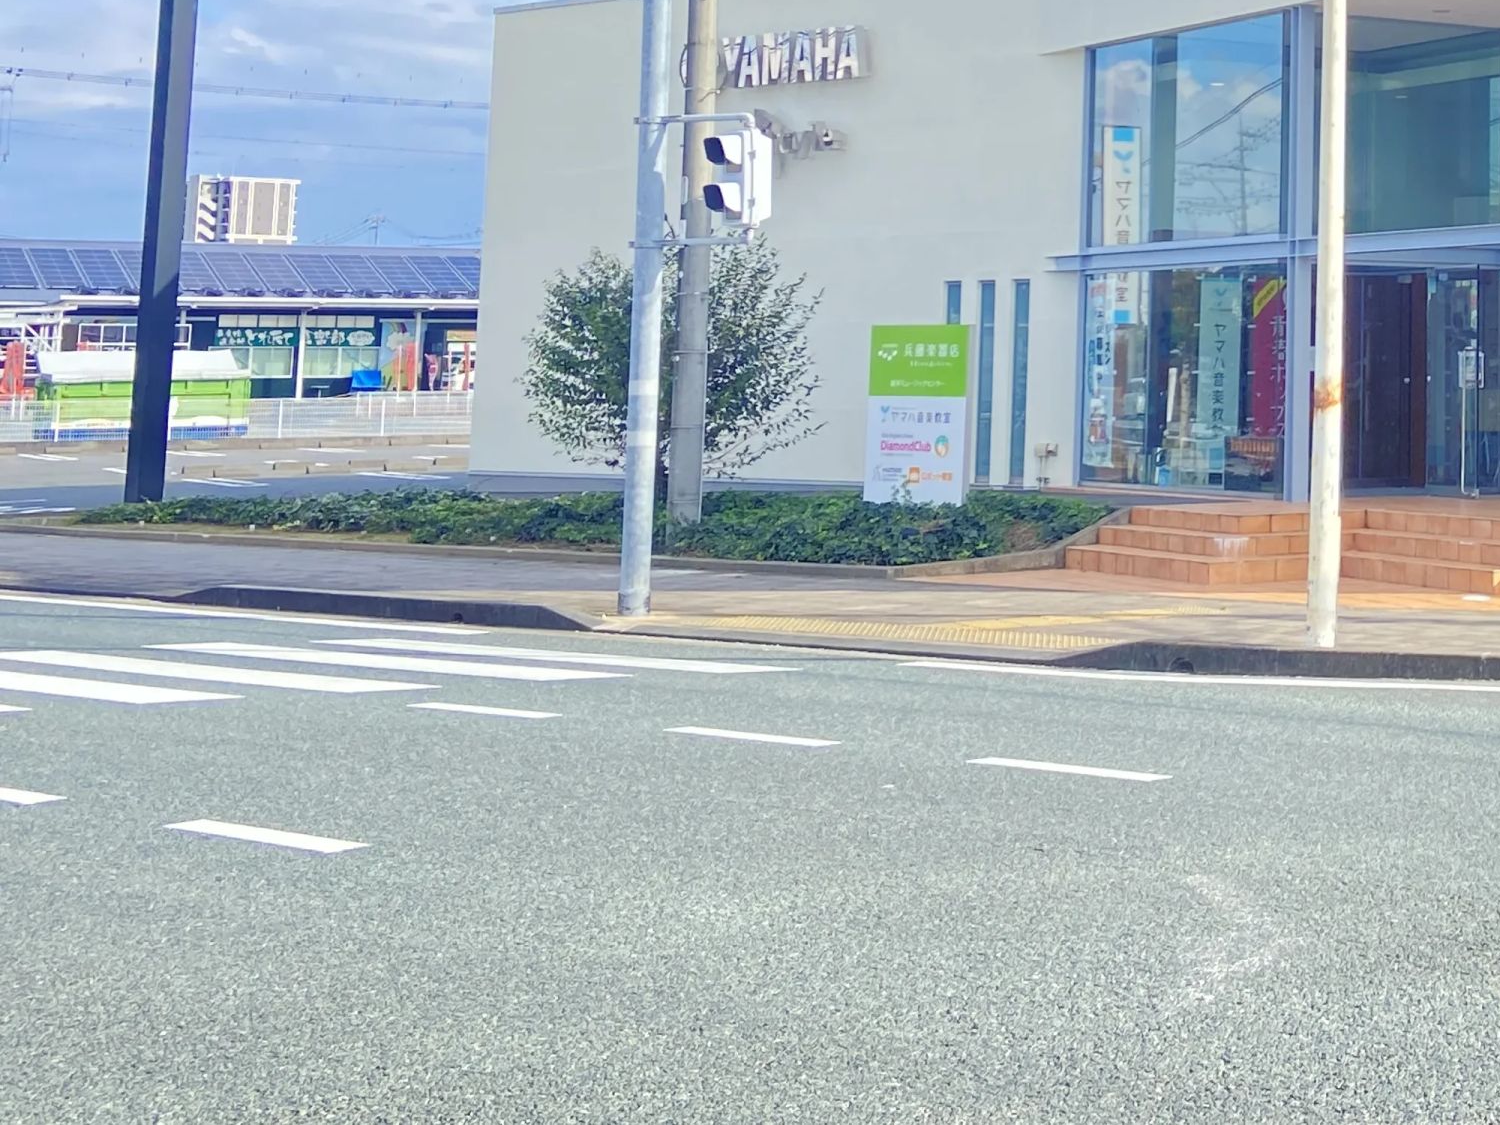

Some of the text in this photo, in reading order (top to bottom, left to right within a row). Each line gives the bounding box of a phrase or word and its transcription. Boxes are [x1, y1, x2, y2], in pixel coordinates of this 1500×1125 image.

[721, 24, 866, 89] YAMAHA
[891, 411, 952, 424] ヤマハ音楽教室
[880, 440, 932, 452] DiamondClub
